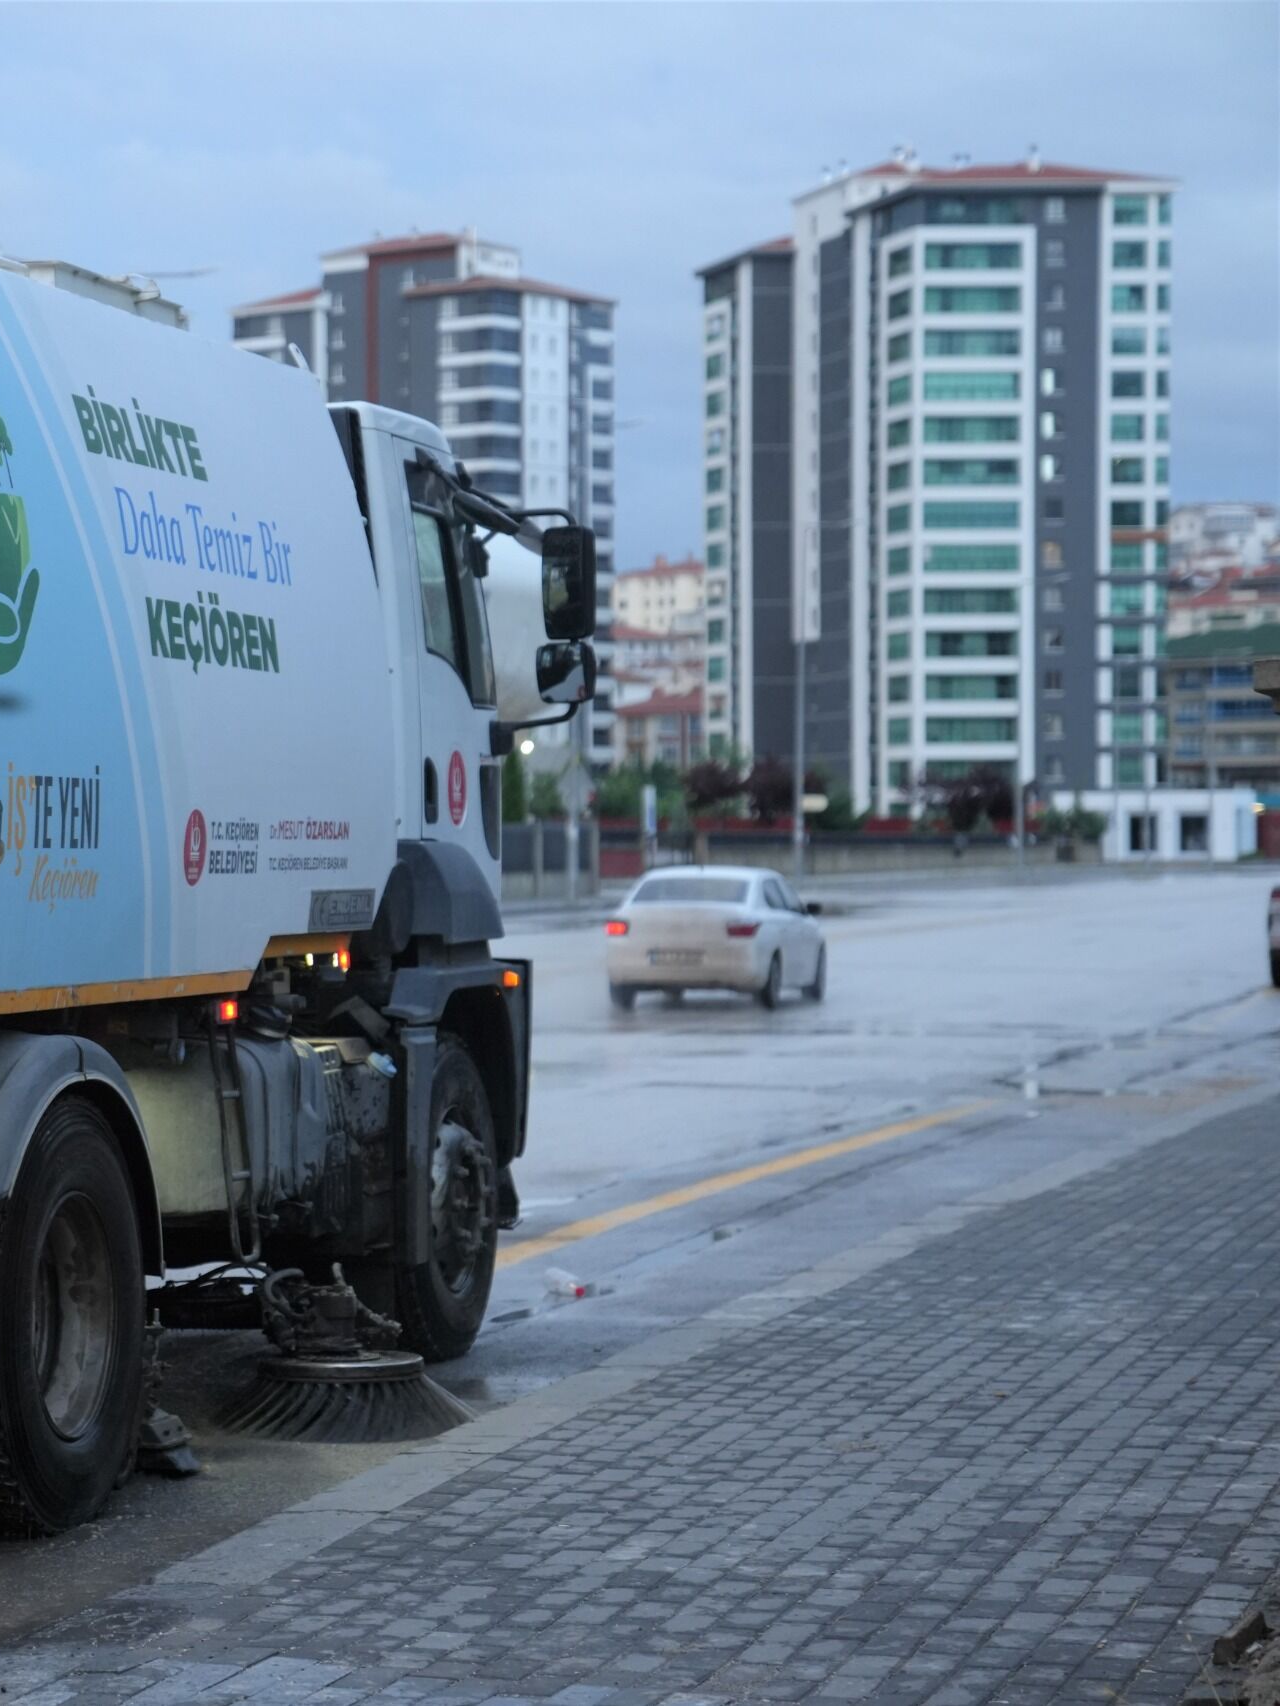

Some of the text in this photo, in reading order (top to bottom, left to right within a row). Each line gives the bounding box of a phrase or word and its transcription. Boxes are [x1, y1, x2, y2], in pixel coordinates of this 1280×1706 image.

[72, 384, 209, 482] BİRLİKTE
[114, 486, 292, 586] Daha Temiz Bir
[145, 591, 280, 675] KEÇİÖREN
[59, 765, 100, 849] YENİ
[211, 817, 260, 843] T.C. KEÇİÖREN
[306, 816, 350, 840] ÖZARSLAN
[28, 854, 100, 915] Keçiören
[209, 844, 259, 874] BELEDİYESİ
